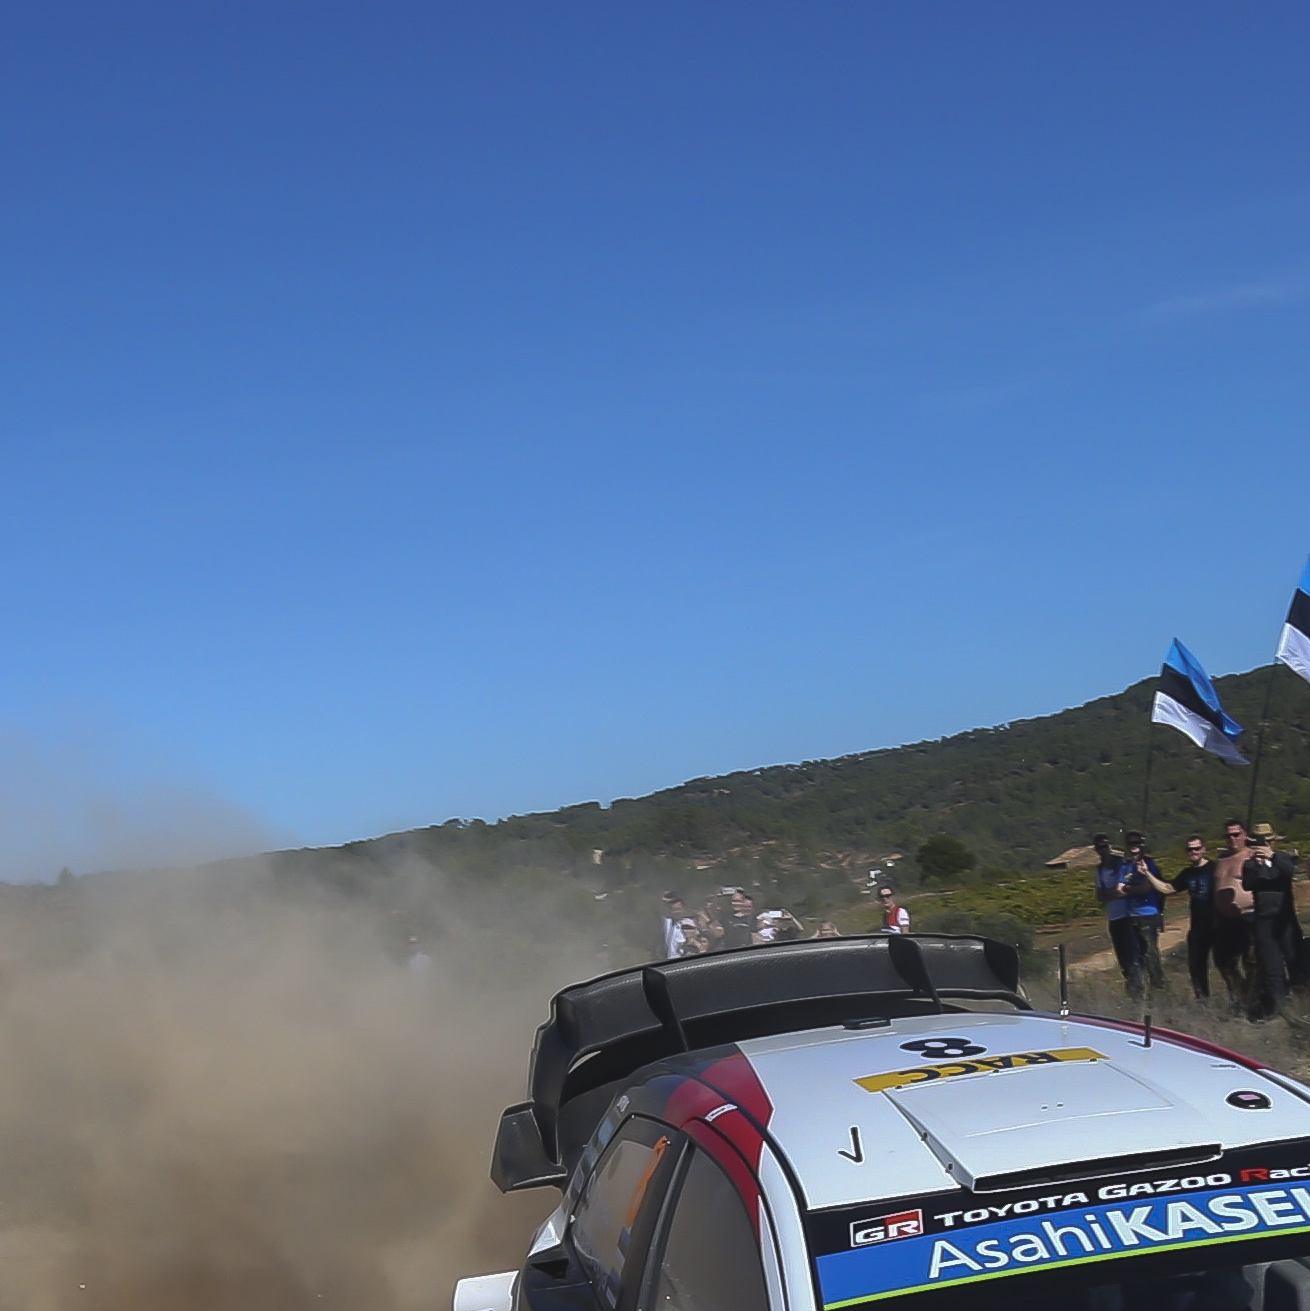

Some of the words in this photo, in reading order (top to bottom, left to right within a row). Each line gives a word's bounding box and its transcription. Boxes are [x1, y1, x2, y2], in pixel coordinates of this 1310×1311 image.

[898, 1036, 989, 1060] 8
[897, 1050, 1064, 1084] RACC
[933, 1191, 1089, 1227] TOYOTA
[1097, 1171, 1233, 1202] GAZOO
[852, 1217, 921, 1244] GR
